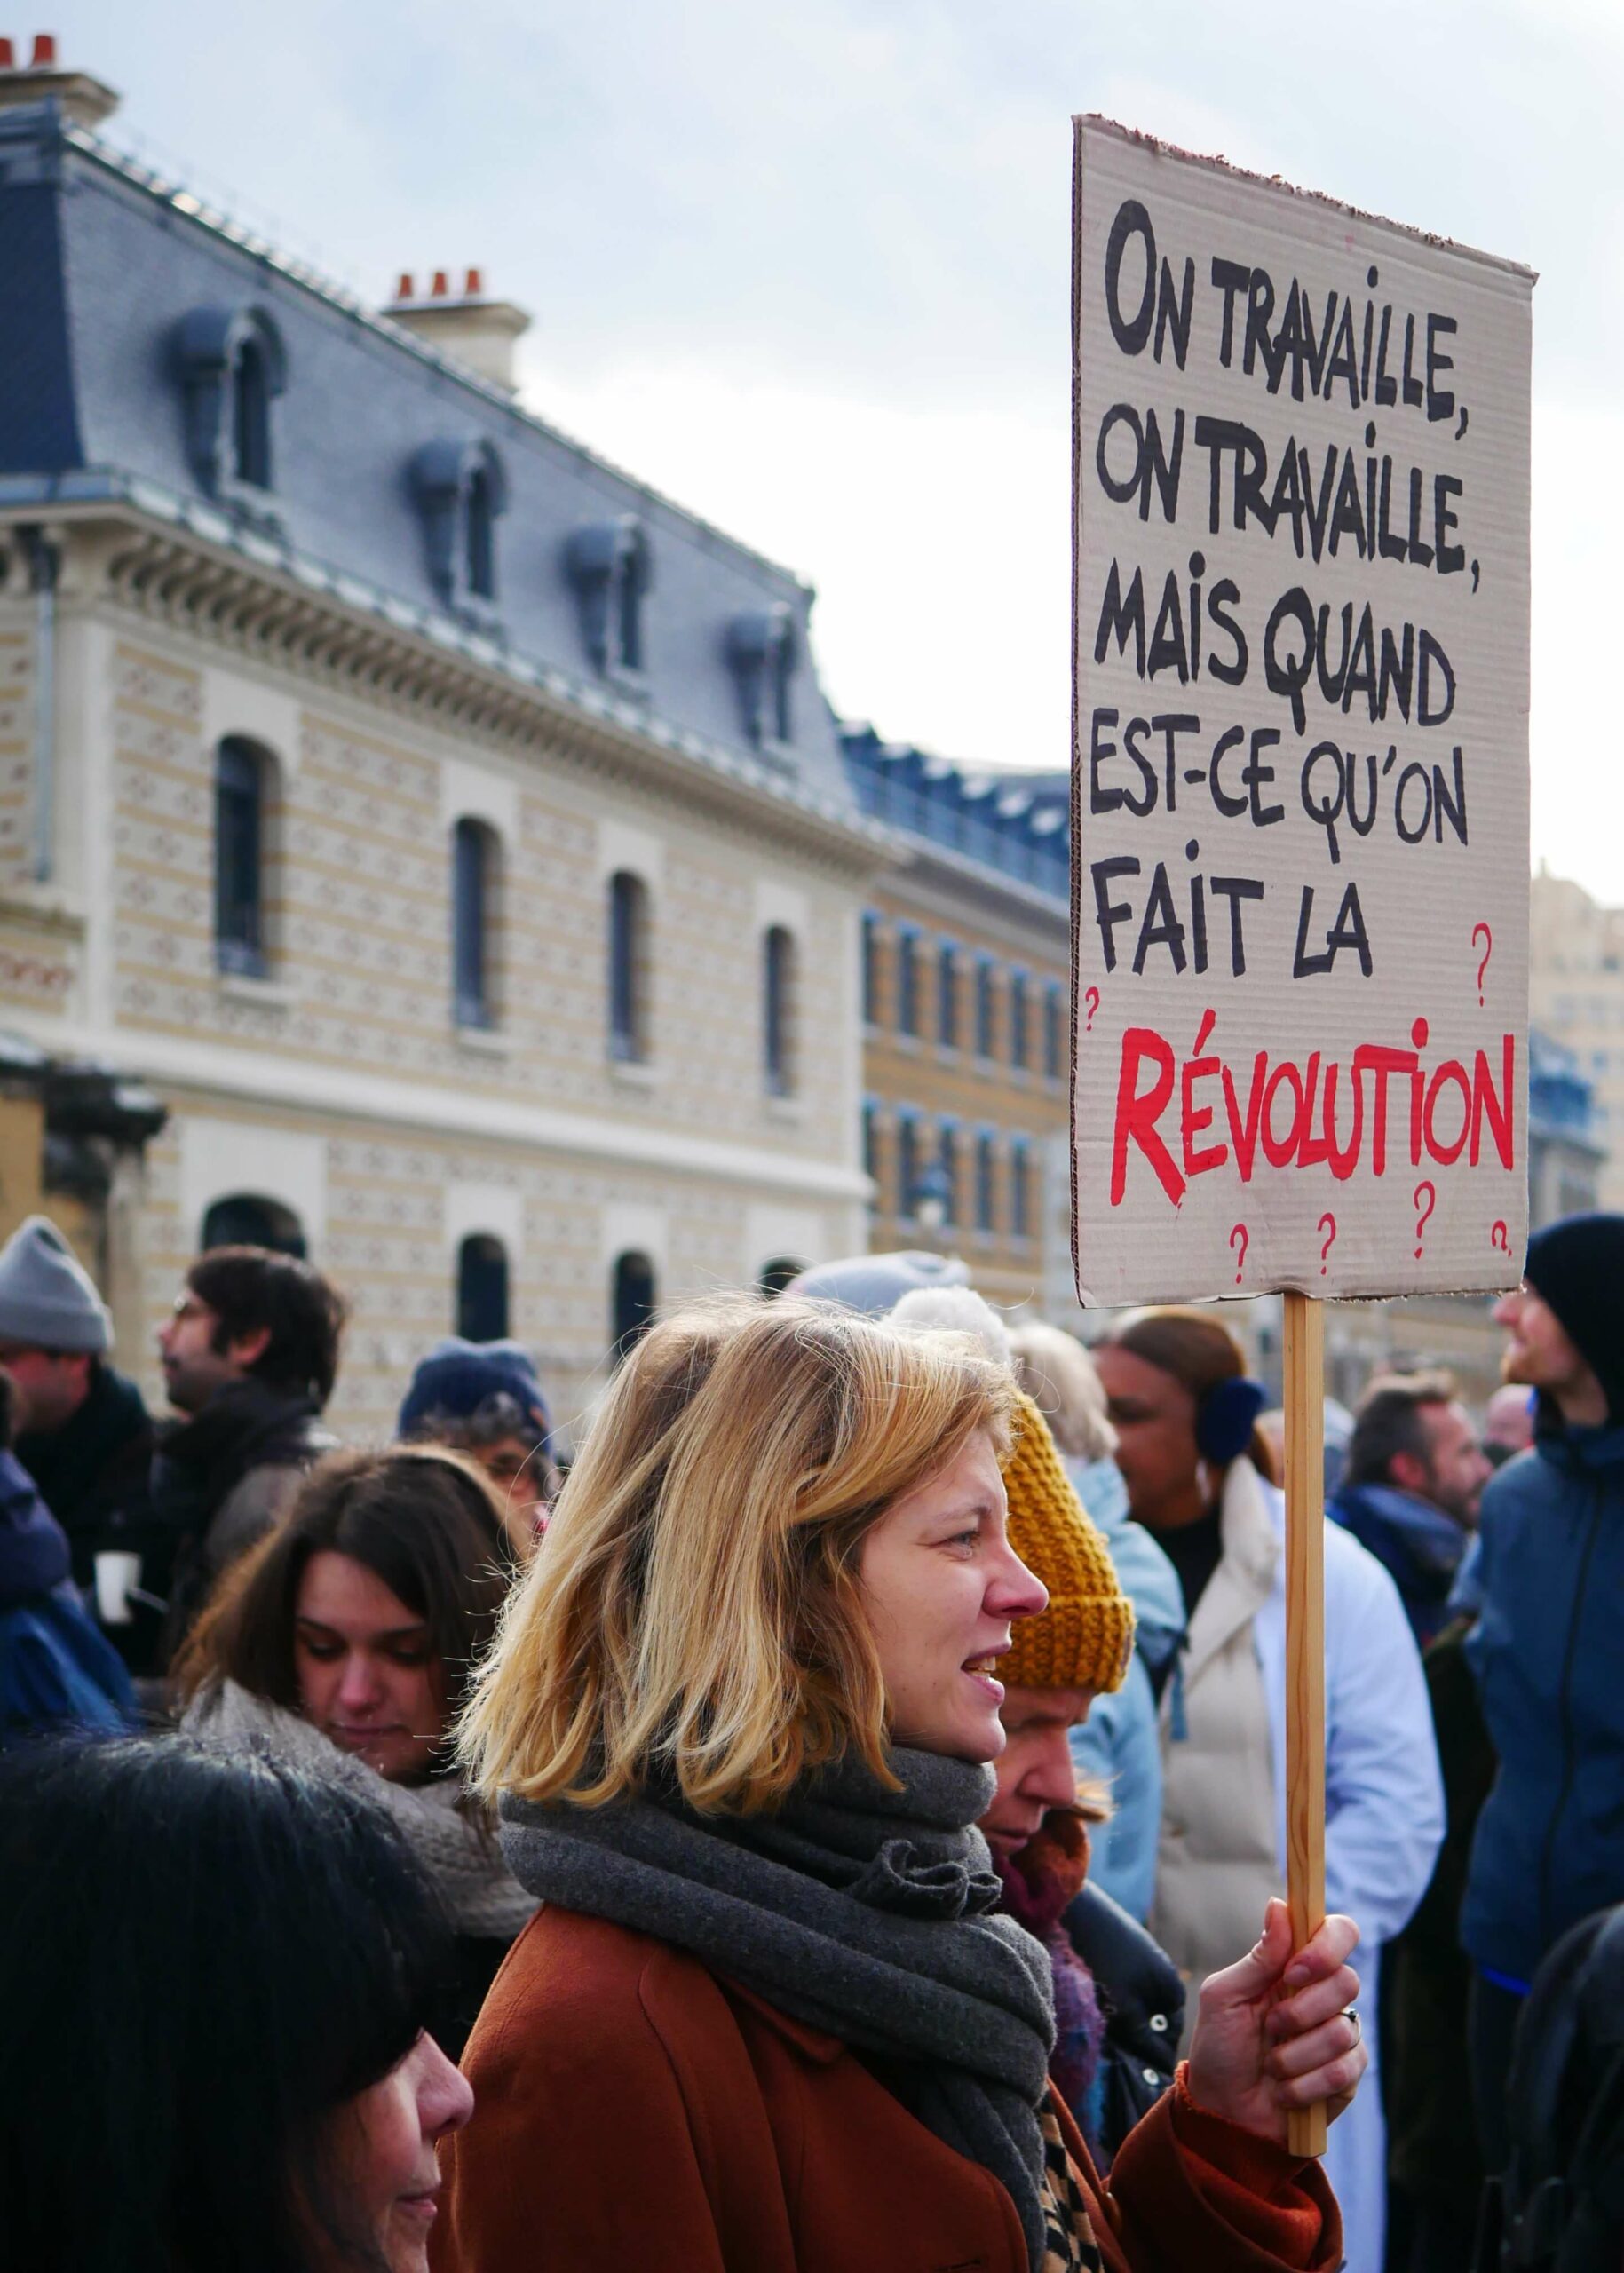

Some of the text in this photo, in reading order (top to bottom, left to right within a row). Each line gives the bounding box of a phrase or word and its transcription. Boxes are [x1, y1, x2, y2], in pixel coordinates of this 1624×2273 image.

[1105, 199, 1196, 372] ON
[1096, 403, 1185, 524] ON
[1263, 586, 1457, 737] QUAND
[1090, 707, 1469, 865] EST-CE QU'ON
[1293, 882, 1373, 979] LA
[1470, 922, 1493, 1008] ?
[1084, 986, 1101, 1033] ?
[1229, 1222, 1250, 1285] ?
[1317, 1212, 1337, 1276] ?
[1413, 1179, 1437, 1260] ?
